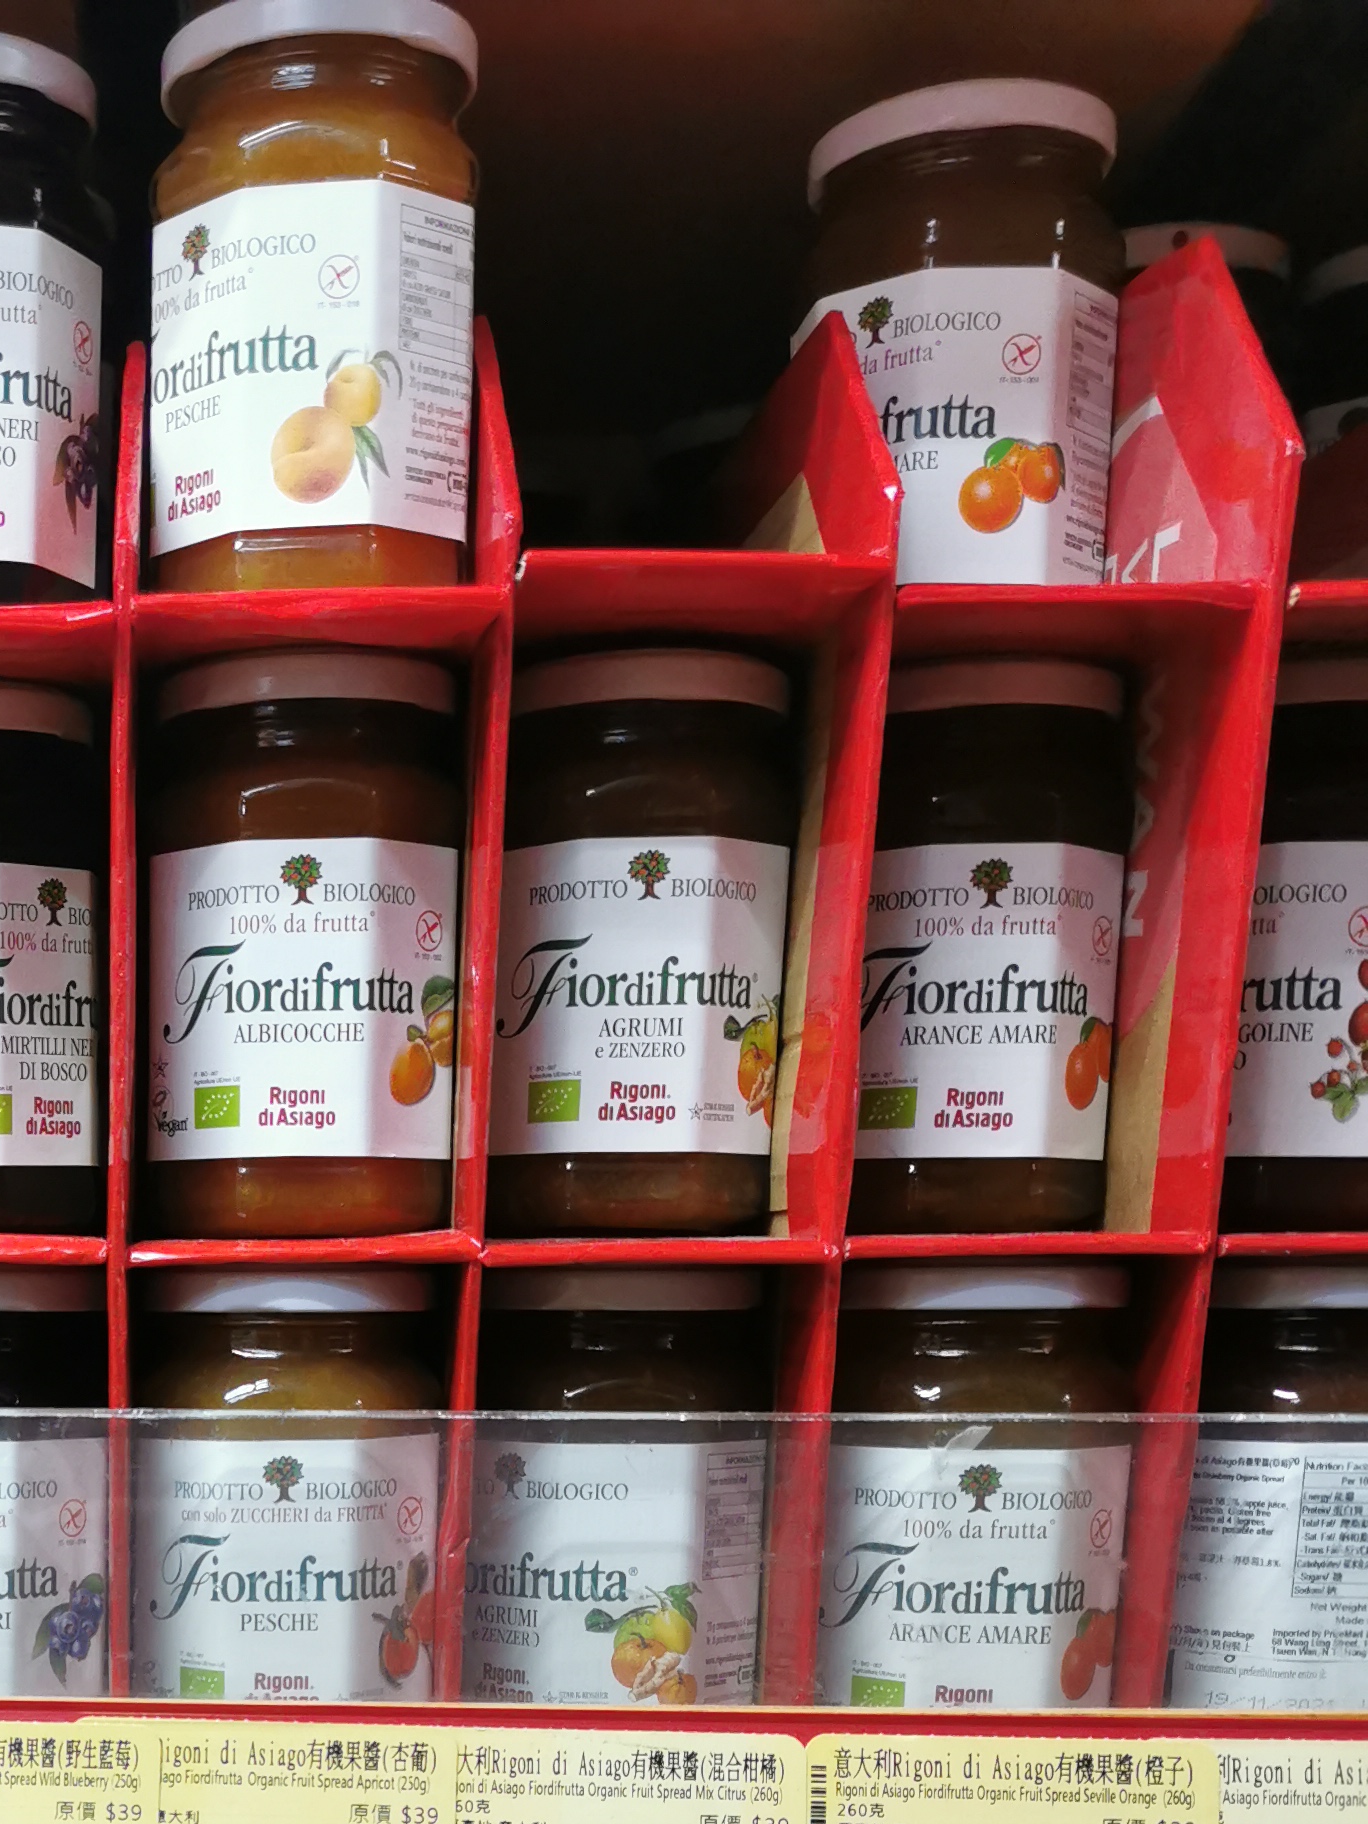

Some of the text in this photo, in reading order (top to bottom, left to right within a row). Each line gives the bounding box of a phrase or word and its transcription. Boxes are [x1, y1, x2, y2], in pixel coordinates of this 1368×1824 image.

[212, 233, 316, 269] BIOLOGICO
[893, 312, 1001, 338] BIOLOGICO
[165, 395, 221, 432] PESCHE
[188, 884, 415, 910] PRODOTTO BIOLOGICO
[529, 880, 756, 905] PRODOTTO BIOLOGICO
[164, 939, 413, 1044] Fiordifrutta
[497, 934, 751, 1039] Fiordifrutta
[234, 1023, 364, 1043] ALBICOCCHE
[599, 1018, 683, 1037] AGRUMI
[901, 1025, 1057, 1045] ARANCE AMARE
[608, 1042, 685, 1058] ZENZERO
[258, 1110, 335, 1128] di Asiago
[598, 1102, 676, 1123] di Asiago
[231, 1508, 308, 1523] ZUCCHERI
[314, 1509, 331, 1523] da
[240, 1613, 318, 1632] PESCHE
[890, 1623, 1051, 1645] ARANCE AMARE
[657, 1786, 746, 1803] Spread Mix Citrus
[836, 1783, 868, 1799] Rigoni
[882, 1785, 915, 1802] Asiago
[918, 1784, 973, 1801] Fiordifrutta
[977, 1786, 1017, 1804] Organic
[1019, 1786, 1042, 1802] Fruit
[1045, 1787, 1080, 1805] Spread
[1083, 1789, 1116, 1804] Seville
[1119, 1790, 1157, 1808] Orange
